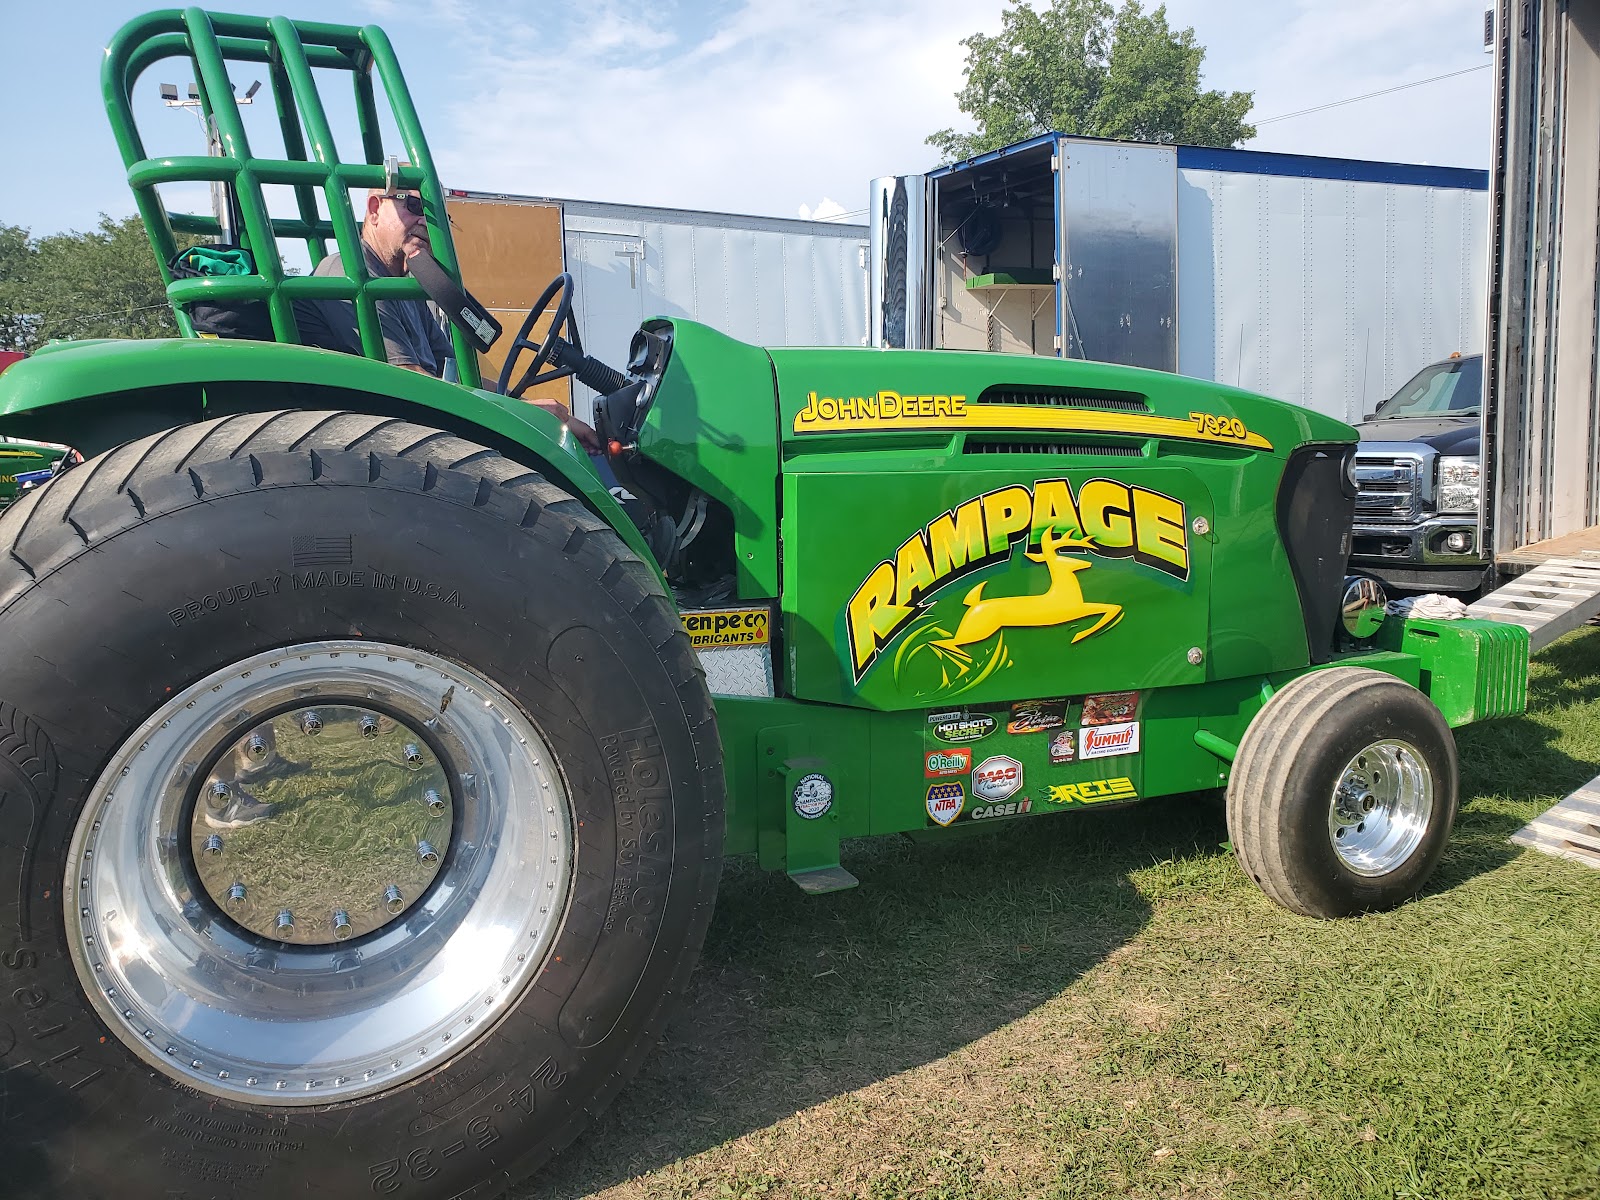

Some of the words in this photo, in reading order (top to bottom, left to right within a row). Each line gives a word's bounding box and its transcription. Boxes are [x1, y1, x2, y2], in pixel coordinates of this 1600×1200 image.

[800, 391, 875, 422] JOHN
[876, 390, 967, 419] DEERE
[1189, 411, 1247, 440] 7920
[846, 477, 1190, 687] RAMPAGE
[167, 573, 283, 627] PROUDLY
[291, 570, 365, 590] MADE
[372, 572, 398, 590] IN
[403, 576, 467, 609] U.S.A.
[938, 722, 958, 732] HOT
[959, 718, 993, 729] SHOT'S
[945, 726, 987, 739] SECRET
[929, 754, 966, 769] O'Reilly
[978, 767, 1017, 784] MAC
[935, 799, 956, 811] NTPA
[971, 802, 1017, 819] CASE
[619, 810, 636, 831] by
[367, 1055, 568, 1195] 24.5-32
